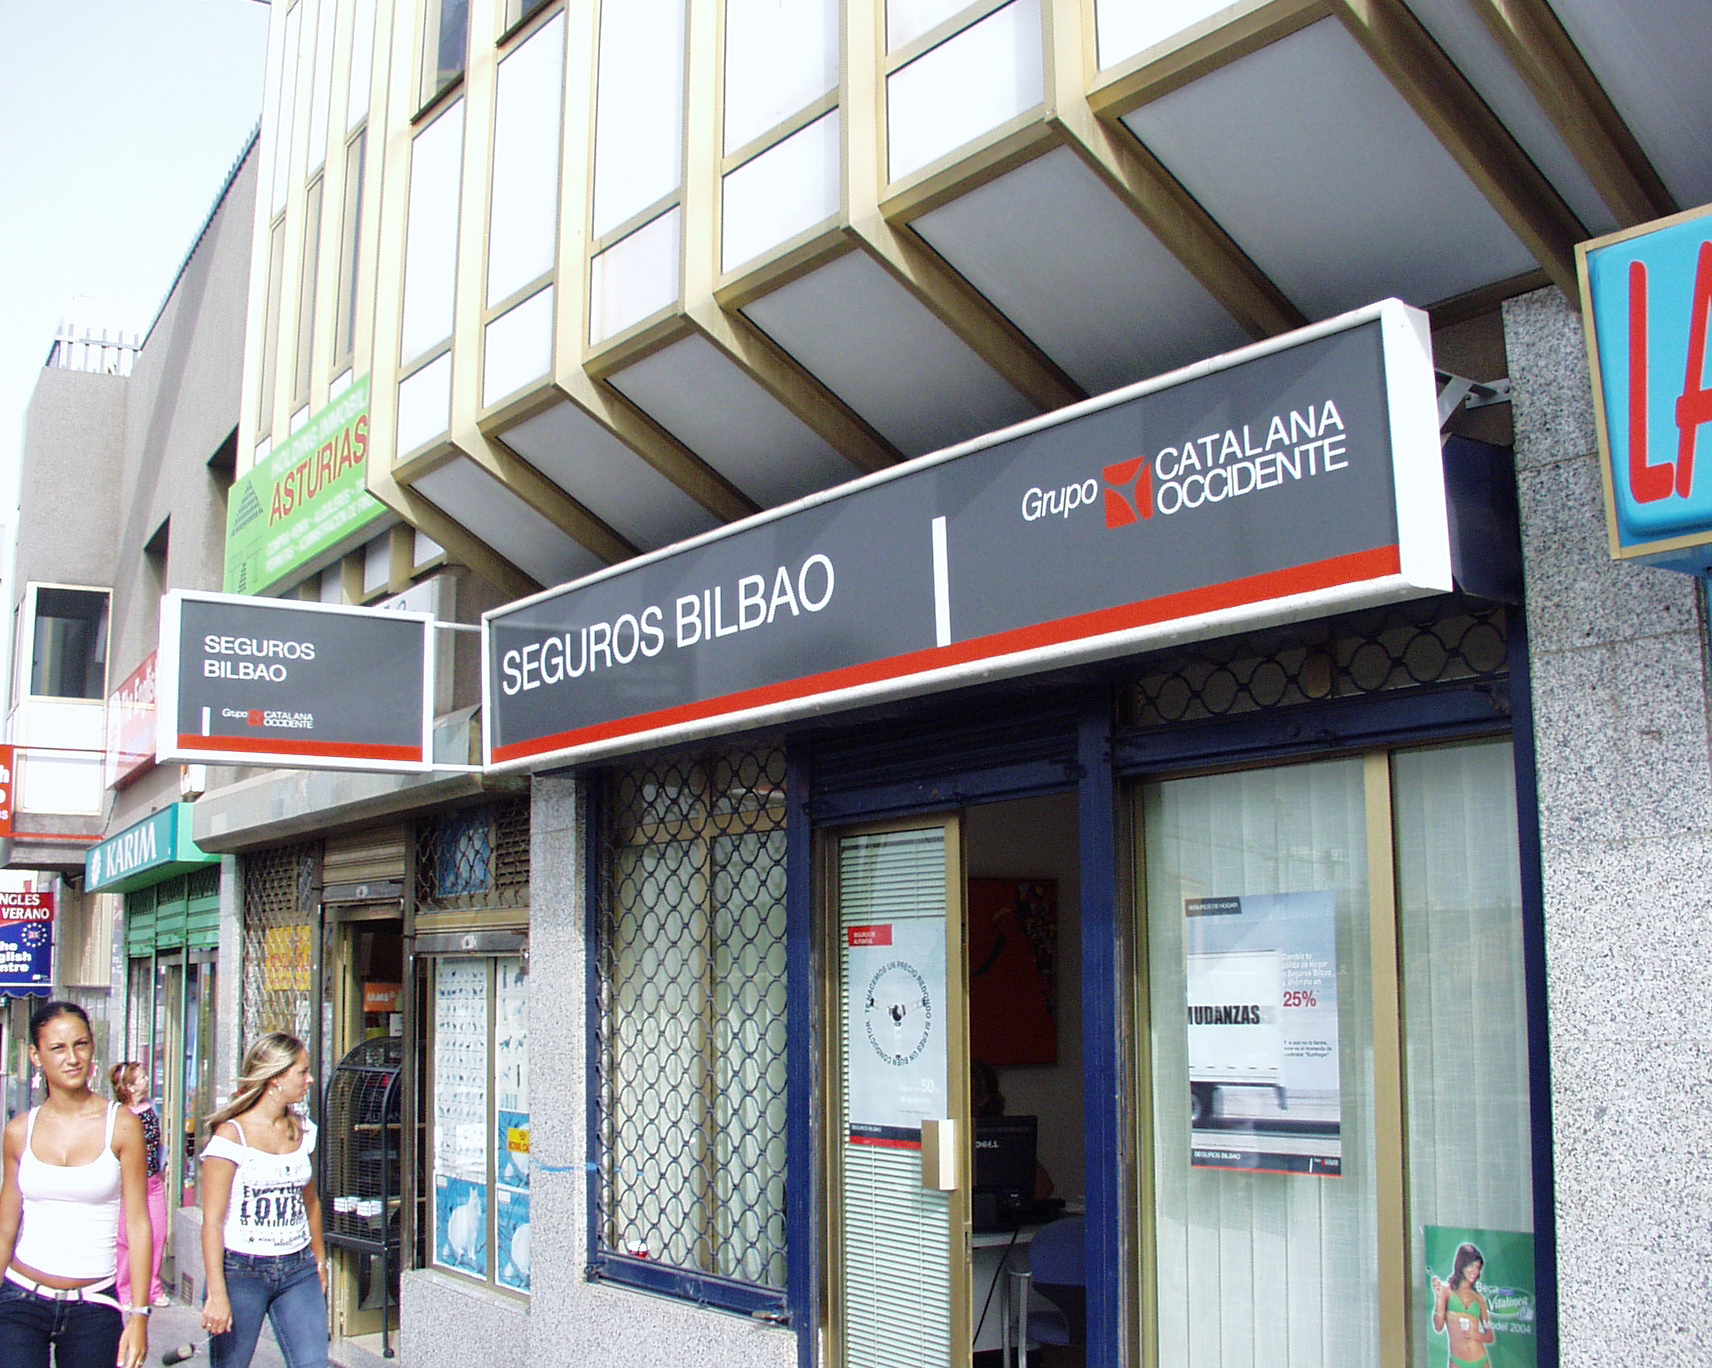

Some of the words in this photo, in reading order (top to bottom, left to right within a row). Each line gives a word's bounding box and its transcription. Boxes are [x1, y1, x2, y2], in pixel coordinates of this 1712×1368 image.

[1156, 400, 1344, 480] CATALANA
[269, 414, 368, 527] ASTURIAS
[1157, 434, 1348, 515] OCCIDENTE
[1021, 479, 1098, 521] Grupo
[503, 606, 664, 695] SEGUROS
[676, 554, 834, 648] BILBAO
[204, 635, 315, 660] SEGUROS
[204, 659, 287, 682] BILBAO
[222, 708, 248, 719] Grupo
[263, 710, 314, 721] CATALANA
[263, 719, 314, 729] OCCIDENTE
[106, 821, 157, 880] KARIM
[2, 906, 50, 920] VERANO
[1283, 990, 1317, 1008] 25%
